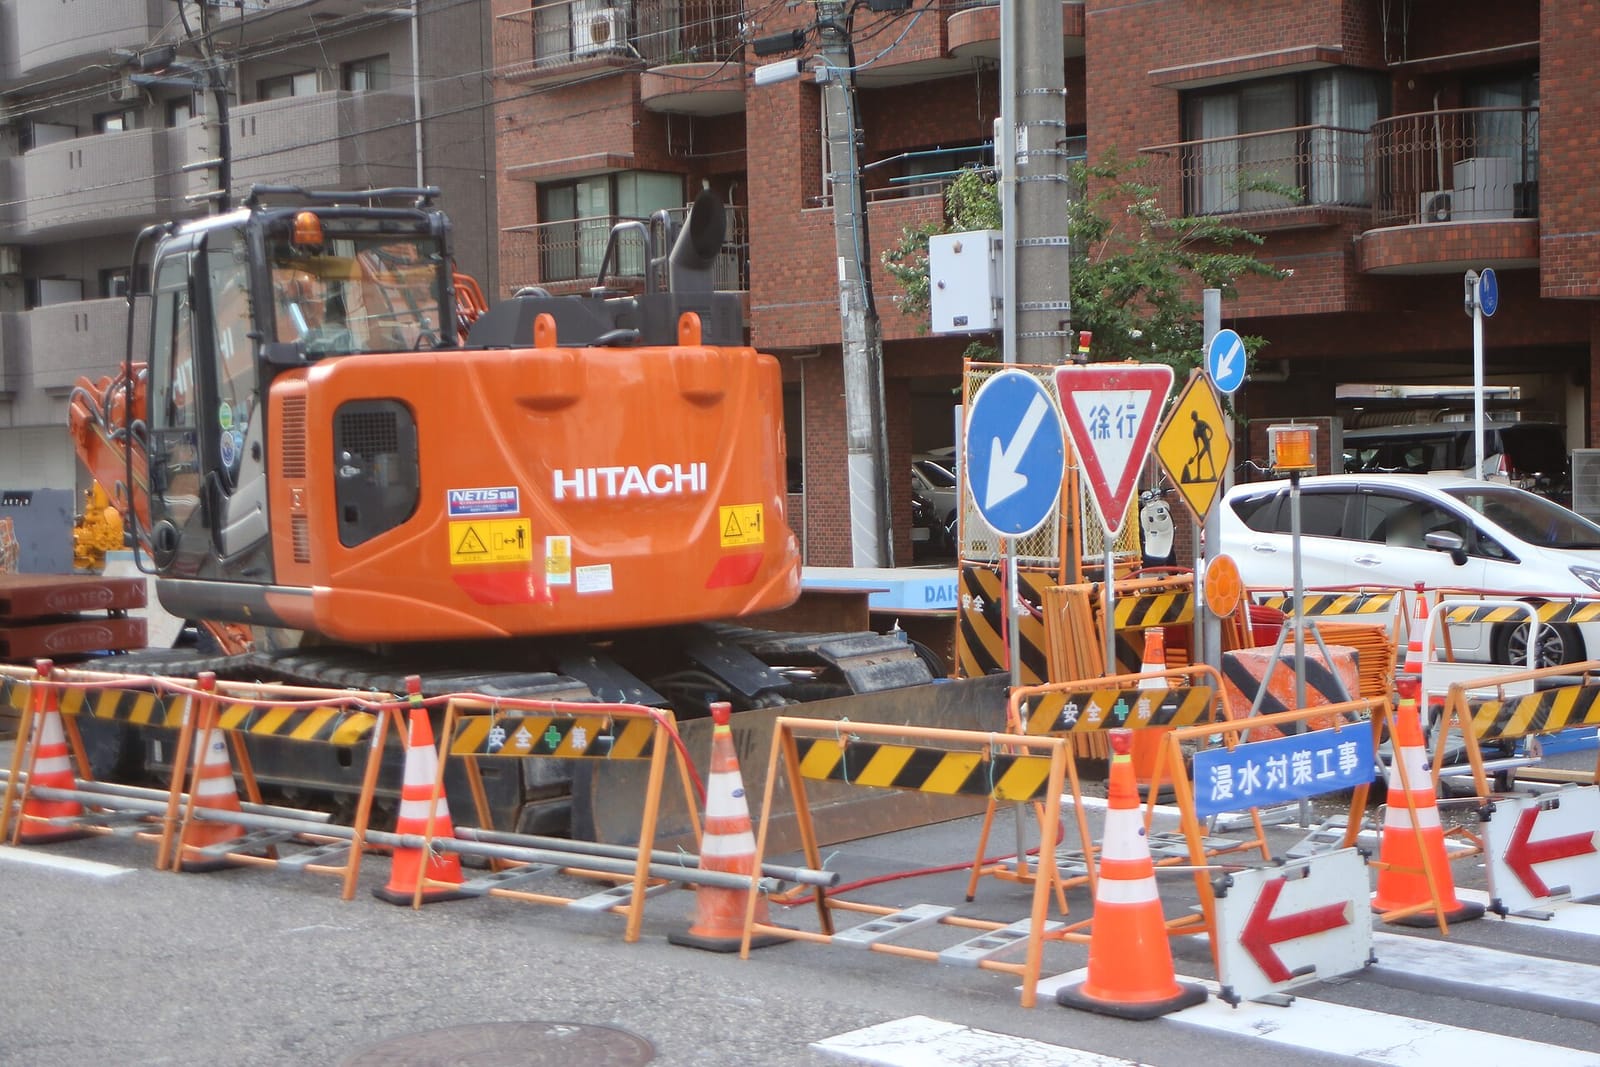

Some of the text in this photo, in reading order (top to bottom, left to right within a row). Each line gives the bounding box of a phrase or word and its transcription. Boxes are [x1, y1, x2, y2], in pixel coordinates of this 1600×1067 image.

[1089, 404, 1137, 440] 徐行
[452, 489, 499, 502] NETIS
[553, 462, 707, 499] HITACHI
[1210, 741, 1359, 801] 浸水対策工事
